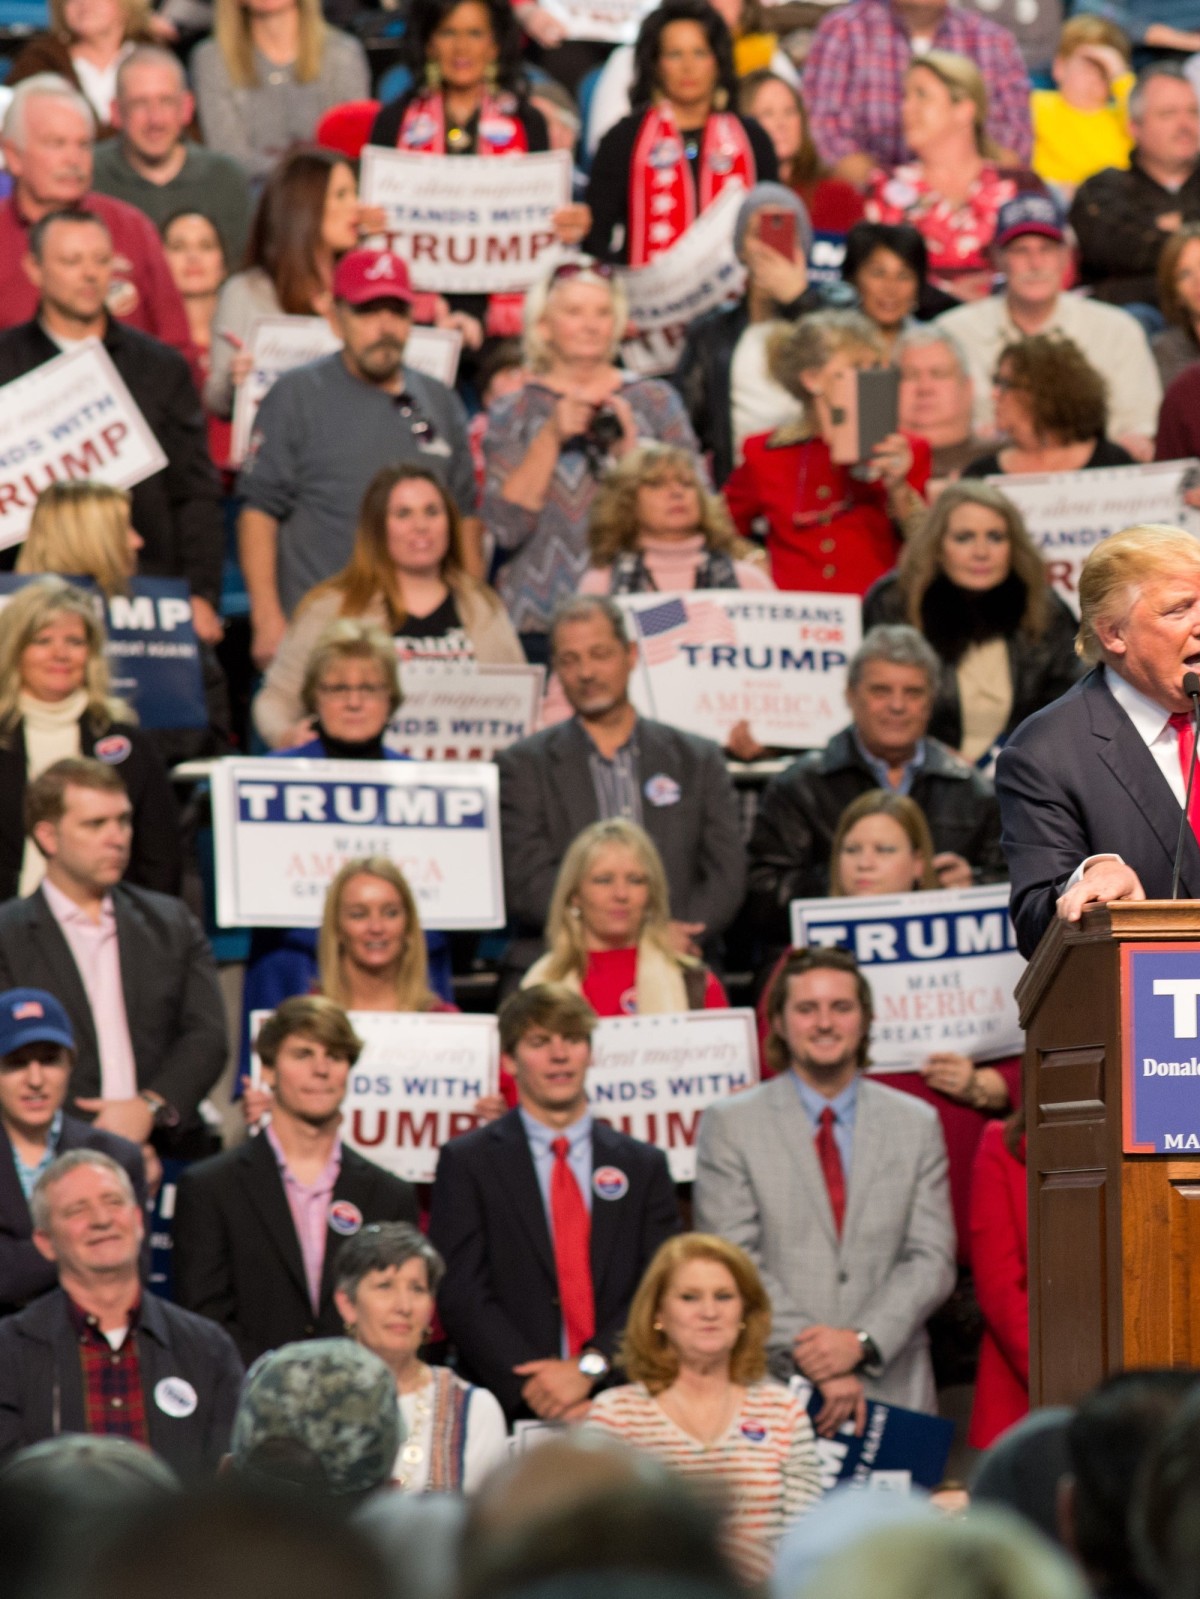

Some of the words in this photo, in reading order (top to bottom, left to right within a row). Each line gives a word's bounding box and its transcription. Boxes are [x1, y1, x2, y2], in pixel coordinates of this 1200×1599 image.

[725, 604, 844, 625] VETERANS
[800, 626, 845, 643] FOR
[678, 644, 849, 673] TRUMP
[239, 783, 483, 826] TRUMP
[907, 972, 962, 990] MAKE
[872, 986, 1006, 1022] MERICA
[872, 1023, 932, 1043] REAT
[402, 1077, 482, 1097] WITH
[588, 1078, 657, 1102] NDS
[669, 1071, 747, 1098] WITH
